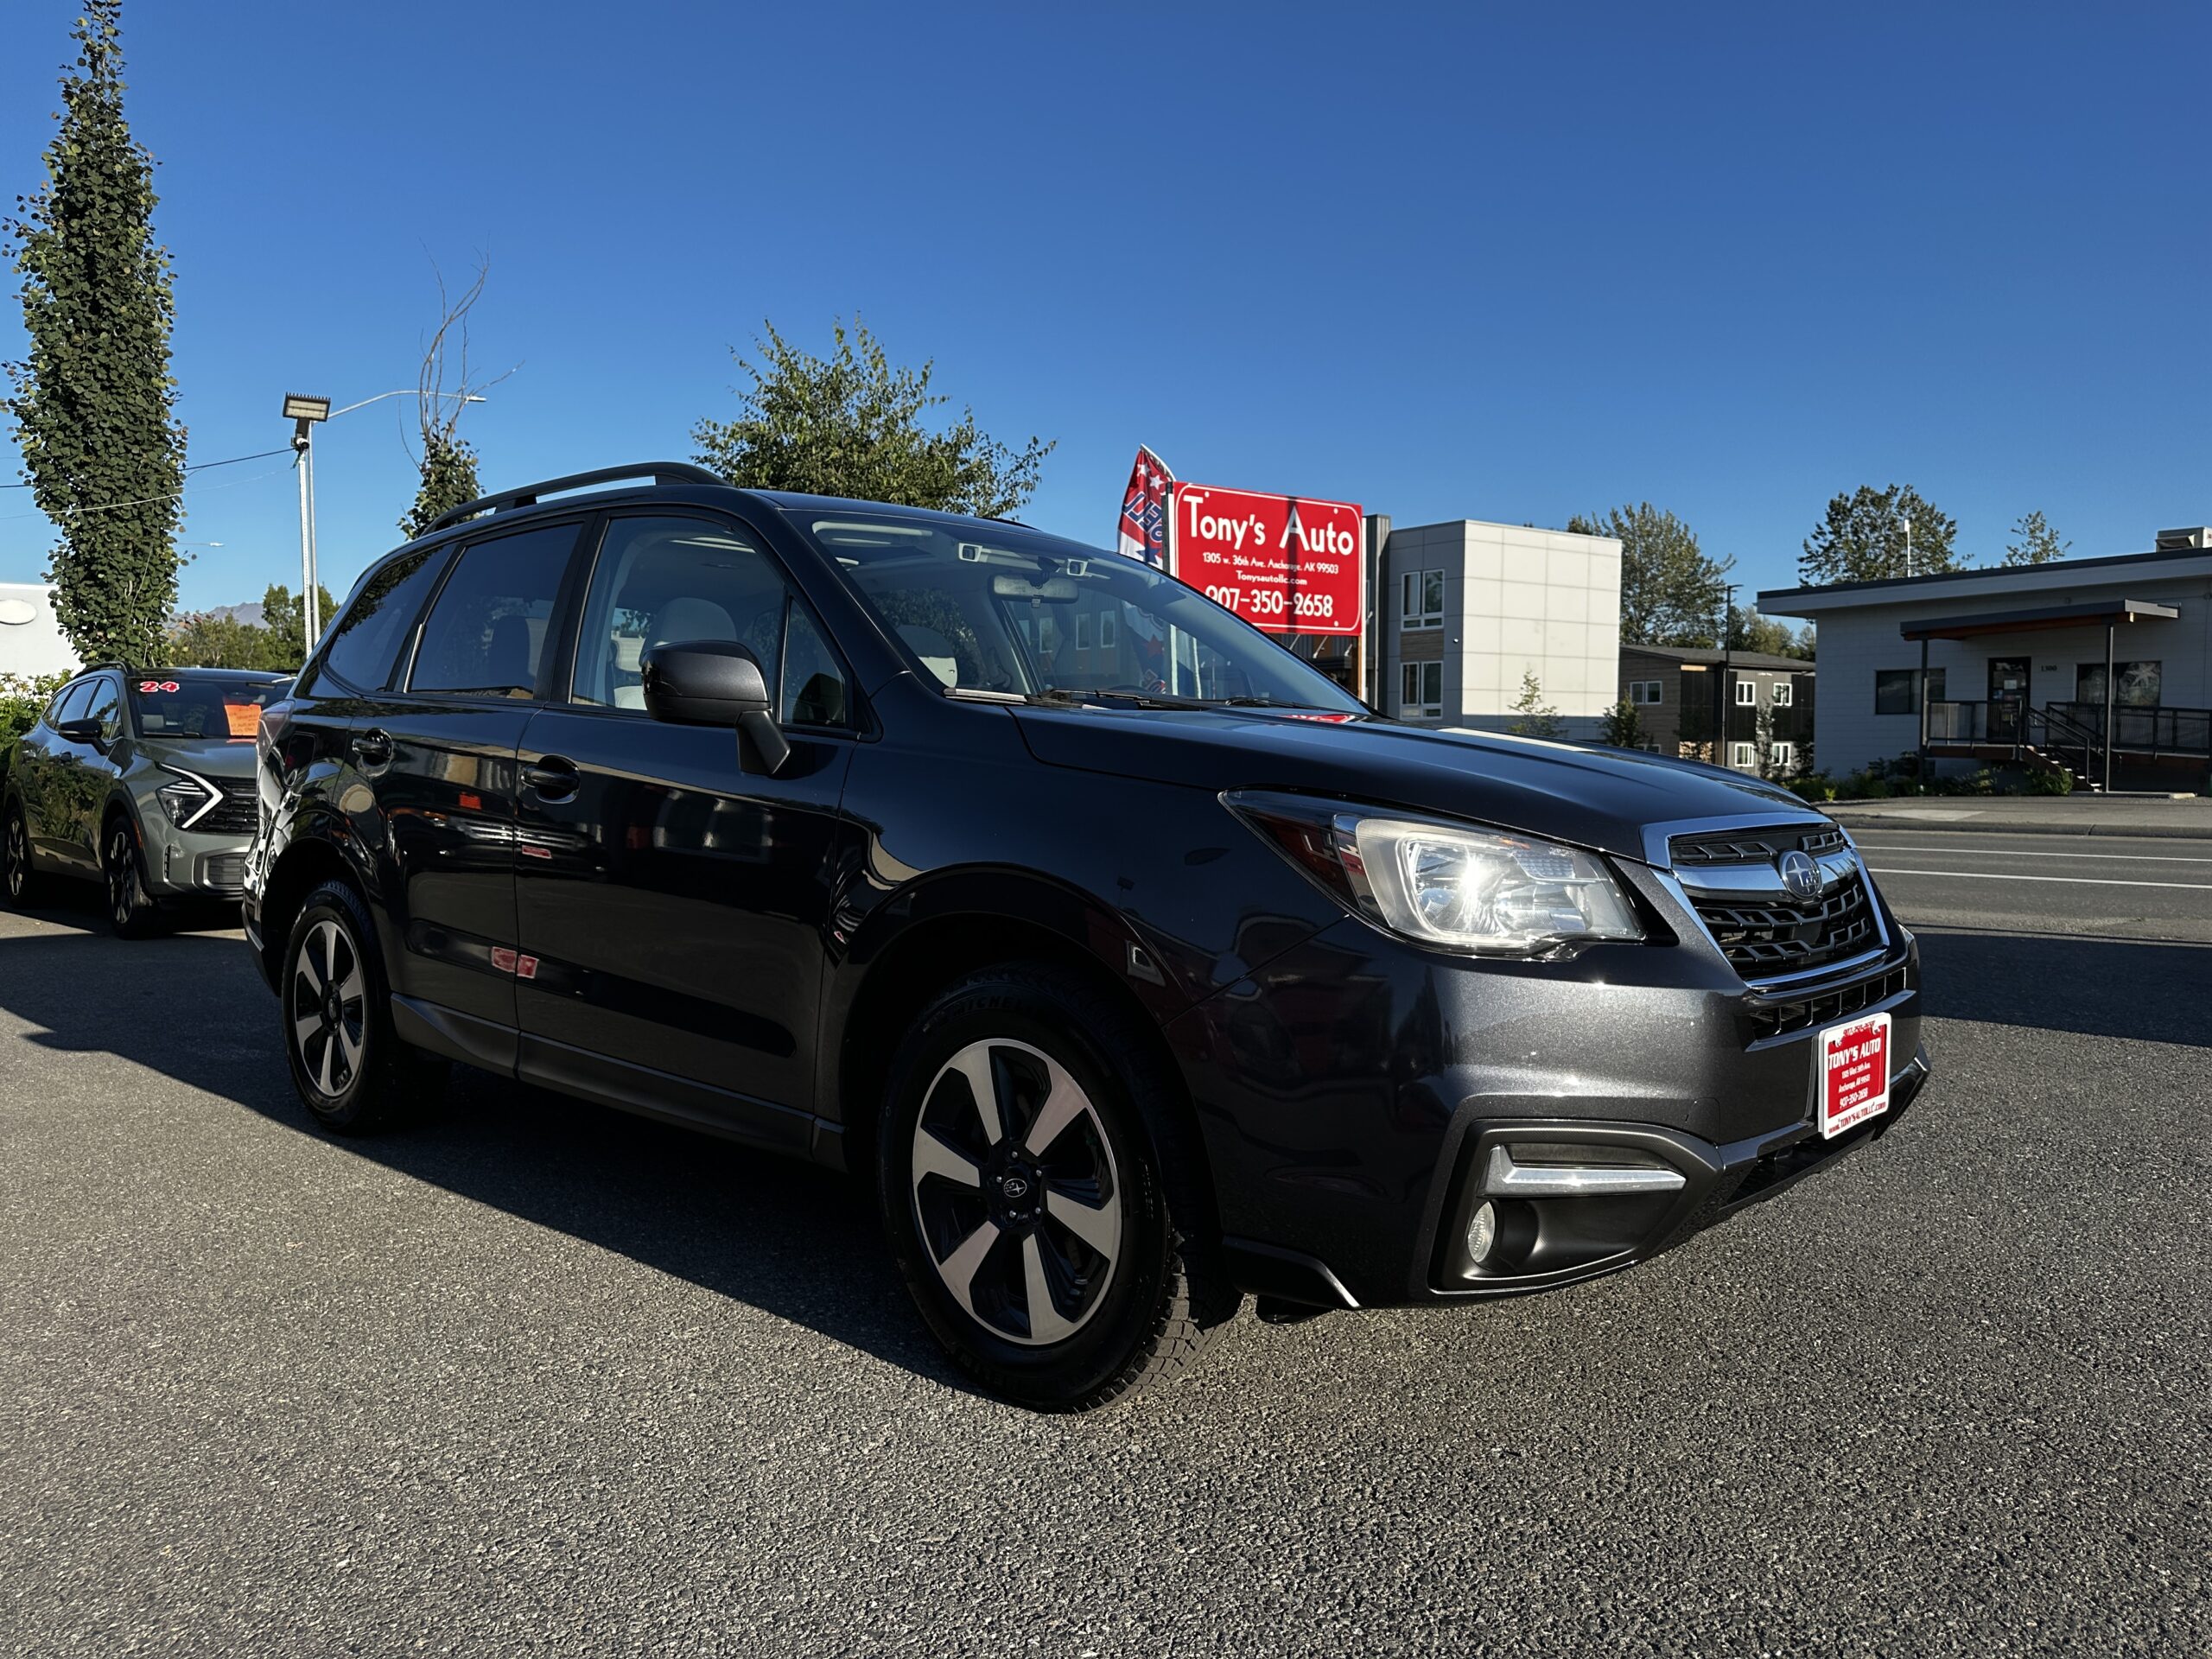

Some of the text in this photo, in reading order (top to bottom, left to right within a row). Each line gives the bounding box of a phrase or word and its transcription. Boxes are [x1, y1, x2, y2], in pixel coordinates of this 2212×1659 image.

[1183, 494, 1354, 556] Tony's Auto
[1203, 552, 1222, 564] 1305
[1232, 555, 1249, 566] 36th
[1303, 562, 1316, 572] AK
[1316, 563, 1339, 575] 99503
[1236, 570, 1307, 586] Tonysautollc.com
[139, 681, 180, 693] 24
[1828, 1037, 1881, 1071] TONY'S AUTO
